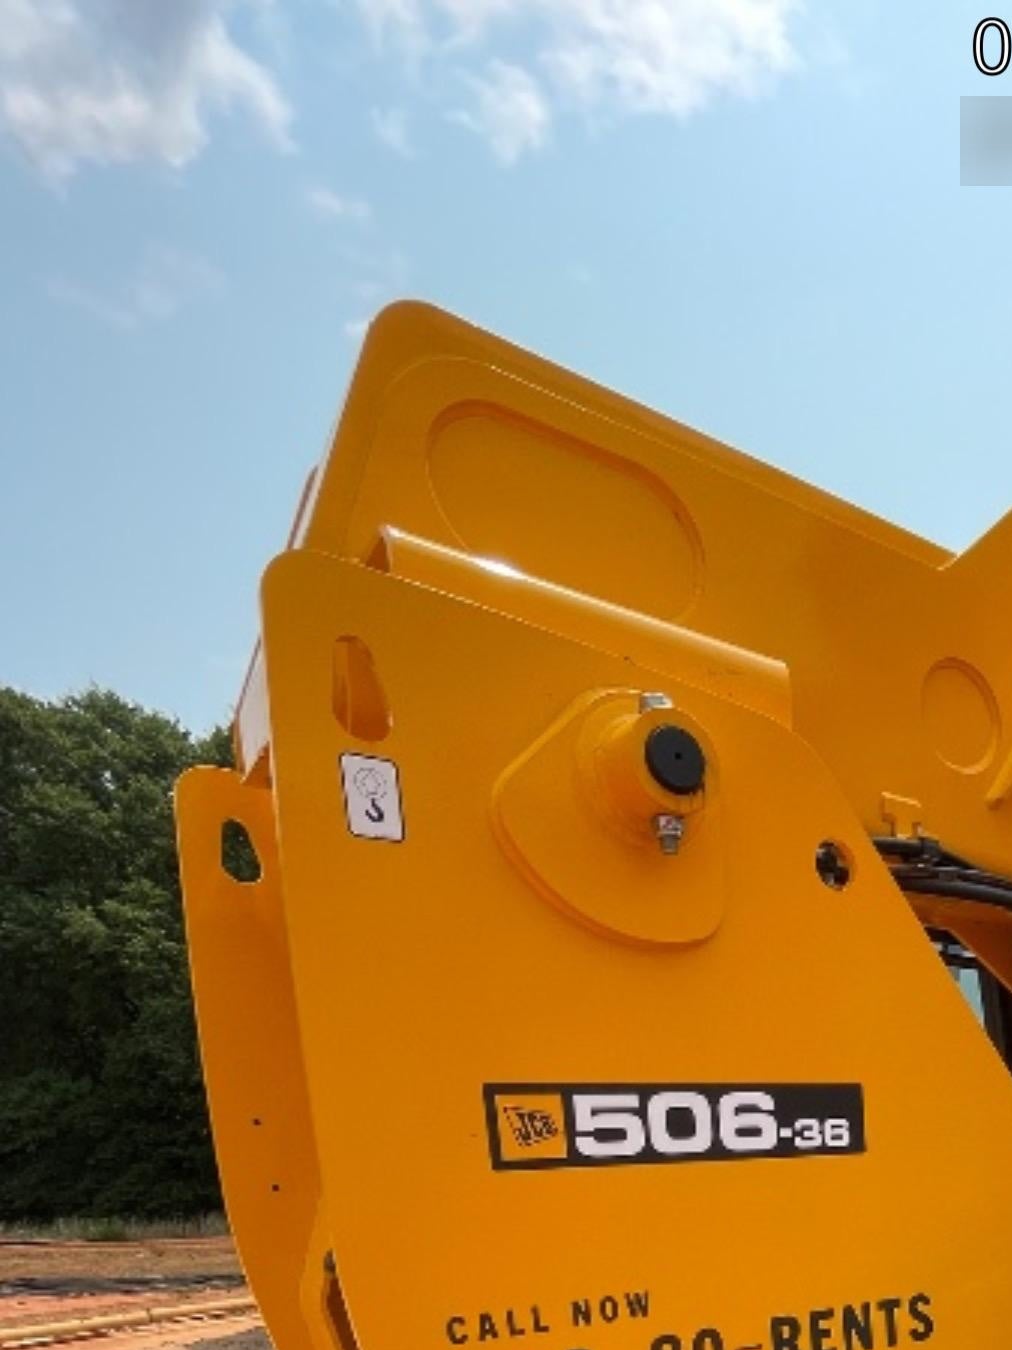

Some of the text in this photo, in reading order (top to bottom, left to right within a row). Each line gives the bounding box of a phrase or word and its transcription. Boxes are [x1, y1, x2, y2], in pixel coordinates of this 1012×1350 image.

[572, 1091, 851, 1158] 506-36
[446, 1290, 651, 1345] CALL NOW
